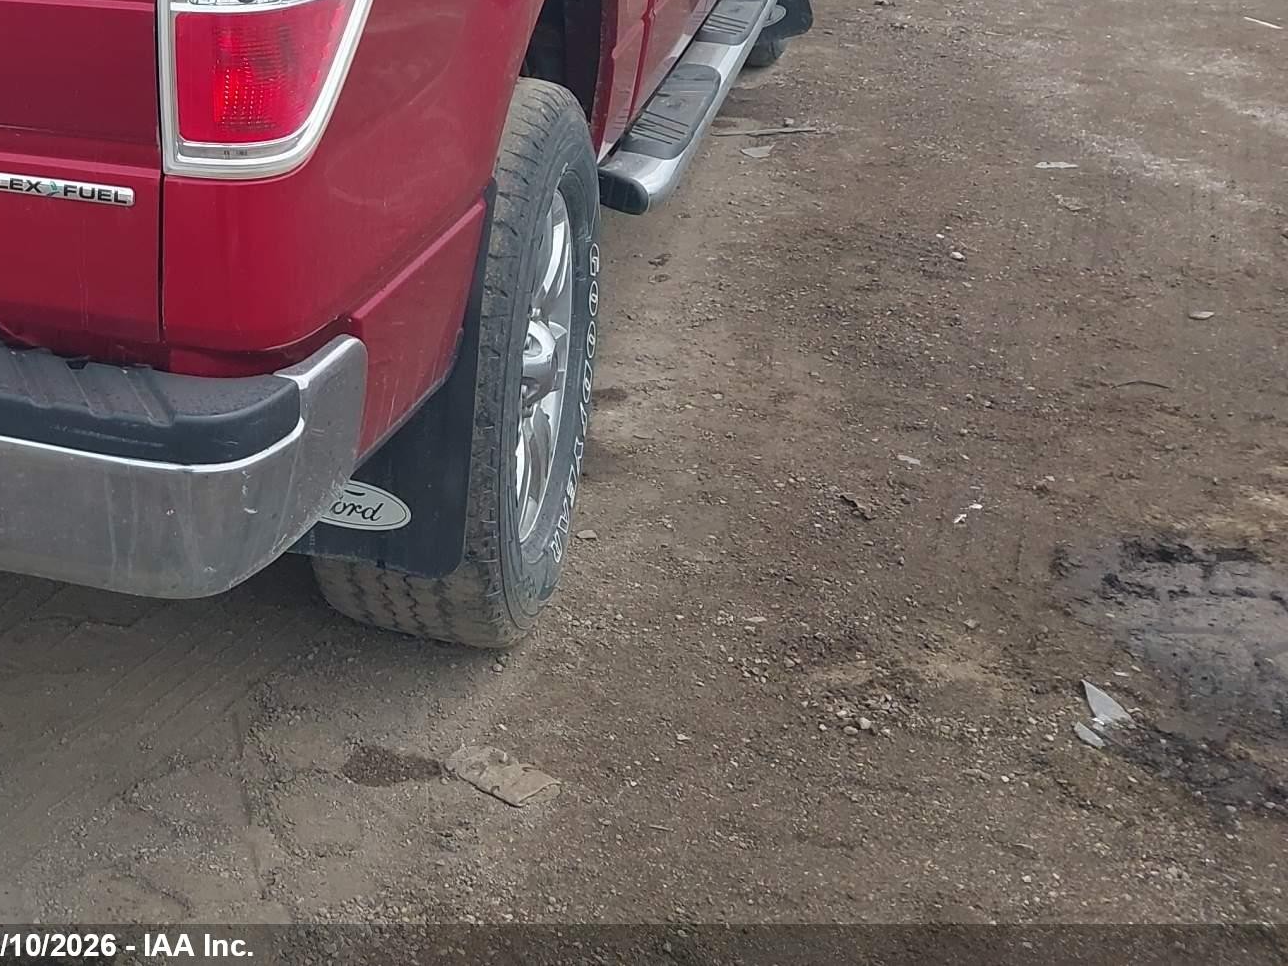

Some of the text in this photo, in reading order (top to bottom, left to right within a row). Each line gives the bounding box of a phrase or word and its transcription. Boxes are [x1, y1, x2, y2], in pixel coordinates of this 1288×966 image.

[63, 184, 129, 205] FUEL
[551, 242, 600, 563] GOODYEAR
[328, 488, 385, 522] ord
